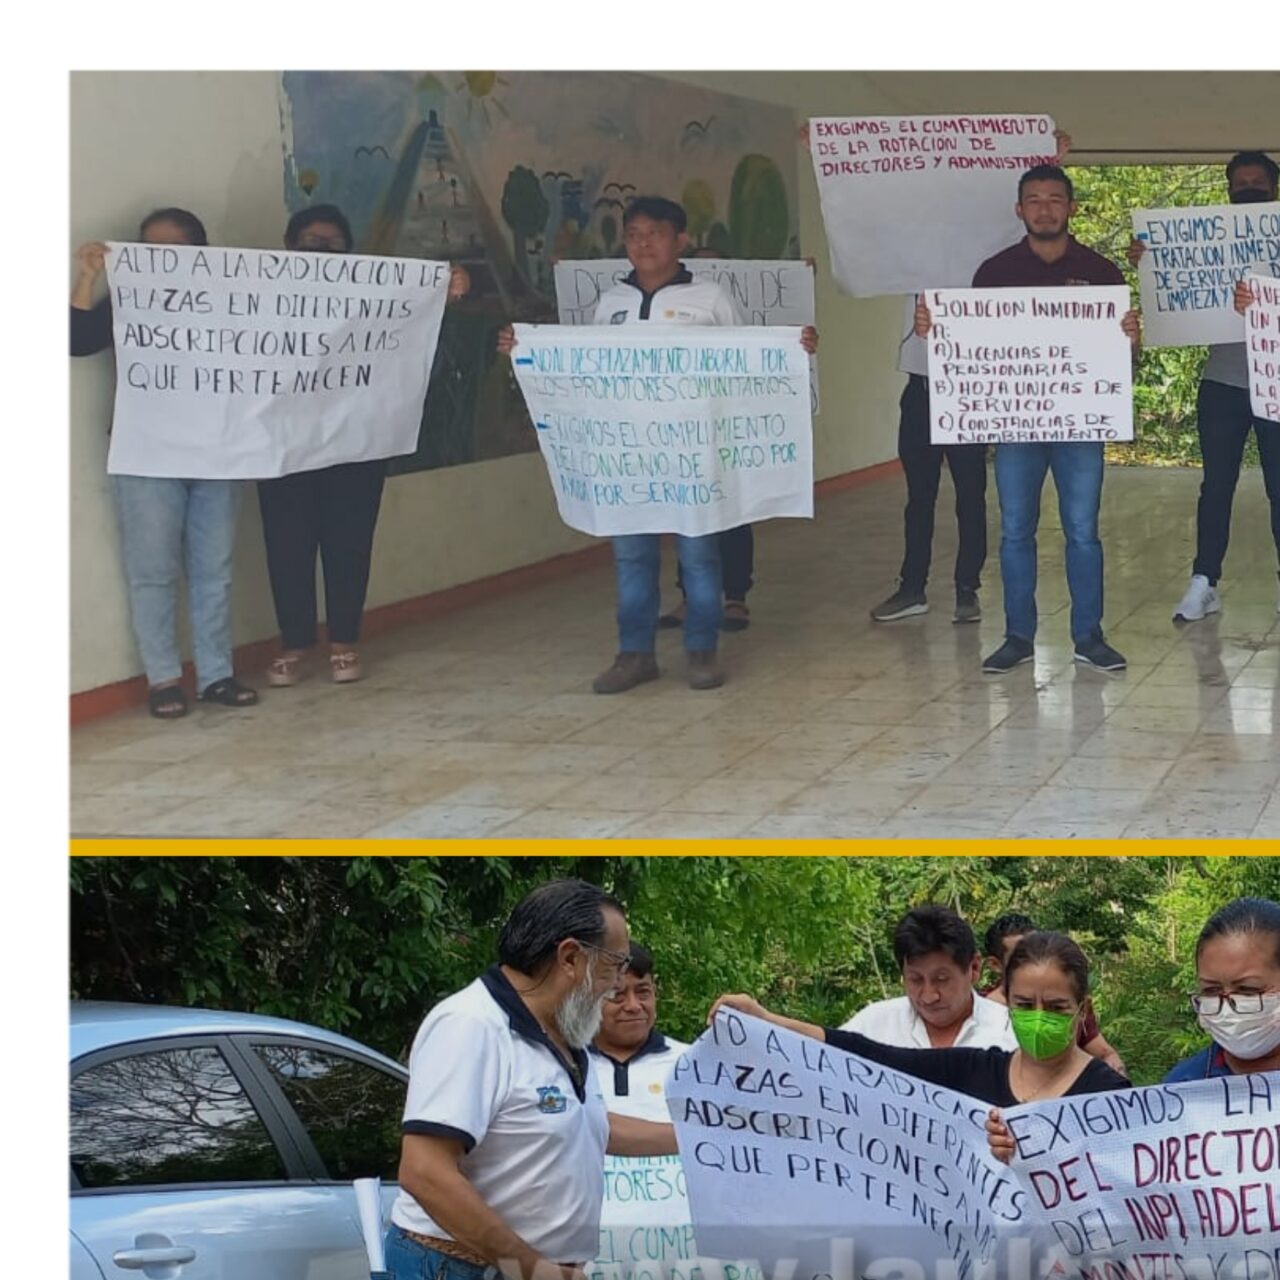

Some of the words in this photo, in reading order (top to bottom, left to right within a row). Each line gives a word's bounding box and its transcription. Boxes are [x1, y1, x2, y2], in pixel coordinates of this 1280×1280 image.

[816, 122, 890, 136] EXIGIMOS
[900, 120, 917, 133] EL
[923, 118, 1048, 135] CUMPLIMIENTO
[819, 141, 841, 155] DE
[849, 139, 869, 154] LA
[970, 138, 995, 150] DE
[820, 155, 925, 177] DIRECTORES
[1234, 214, 1254, 239] LA
[114, 248, 178, 274] ALTO
[192, 251, 211, 276] A
[223, 253, 249, 279] LA
[258, 256, 404, 287] RADICACION
[117, 289, 212, 313] PLAZAS
[230, 292, 259, 316] EN
[935, 292, 1024, 318] SOLUCION
[1032, 298, 1116, 318] INMEDIATA
[1251, 311, 1269, 330] UN
[124, 324, 330, 356] ADSCRIPCIONES
[365, 330, 399, 351] LAS
[1048, 345, 1071, 359] DE
[128, 363, 178, 391] QUE
[195, 365, 371, 395] PERTENECEN
[943, 361, 1088, 377] PENSIONARIAS
[960, 381, 1009, 396] HOJA
[1016, 380, 1082, 395] UNICAS
[1095, 380, 1122, 394] DE
[1255, 383, 1277, 400] LA
[958, 397, 1055, 413] SERVICIO
[958, 427, 1118, 444] NOMBRAMIENTO
[959, 413, 1077, 433] CONSTANCIAS
[1085, 413, 1112, 426] DE
[679, 453, 704, 478] DE
[766, 1029, 789, 1062] A
[802, 1041, 836, 1075] LA
[1008, 1083, 1184, 1159] EXIGIMOS
[1223, 1073, 1270, 1115] LA
[675, 1054, 802, 1098] PLAZAS
[821, 1087, 858, 1116] EN
[882, 1102, 1025, 1221] DIFERENTES
[684, 1098, 949, 1197] ADSCRIPCIONES
[695, 1141, 773, 1174] QUE
[1029, 1151, 1112, 1209] DEL
[1052, 1209, 1128, 1256] DEL
